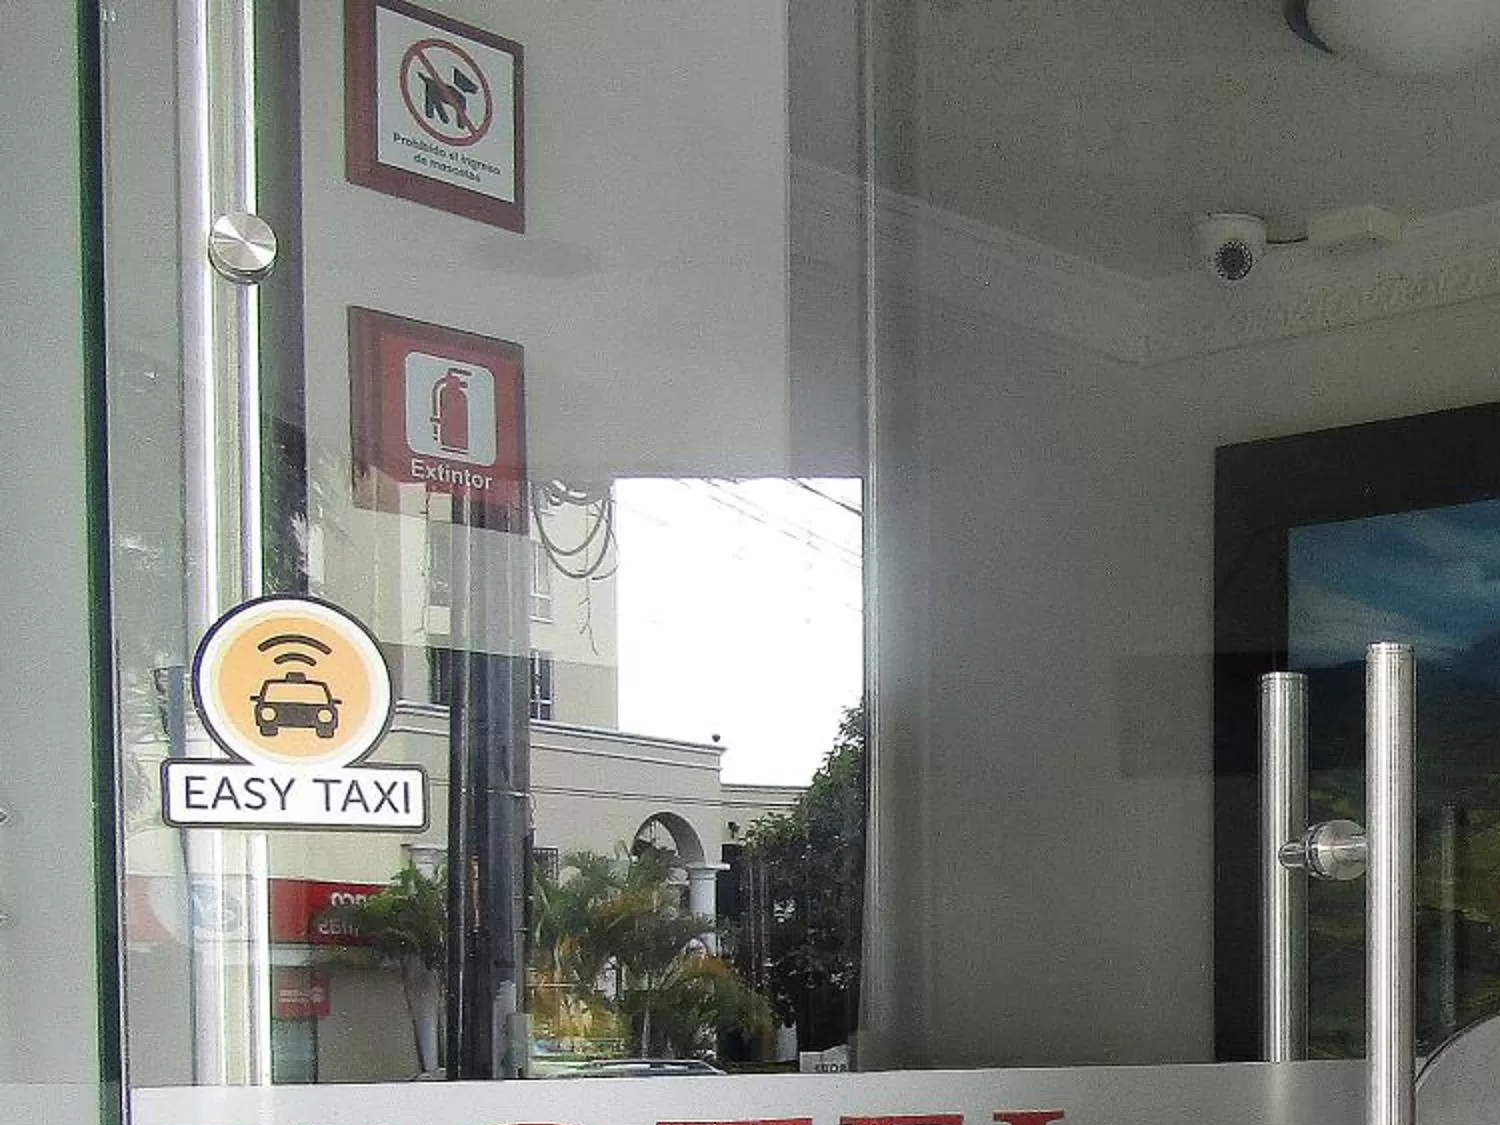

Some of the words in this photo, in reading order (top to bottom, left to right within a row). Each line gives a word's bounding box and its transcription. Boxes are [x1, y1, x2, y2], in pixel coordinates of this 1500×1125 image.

[393, 131, 447, 158] Prohibido
[461, 154, 501, 176] ingreso
[414, 153, 428, 166] de
[430, 159, 481, 182] mascotas
[411, 457, 493, 490] Extintor
[184, 775, 296, 811] EASY
[312, 778, 411, 814] TAXI
